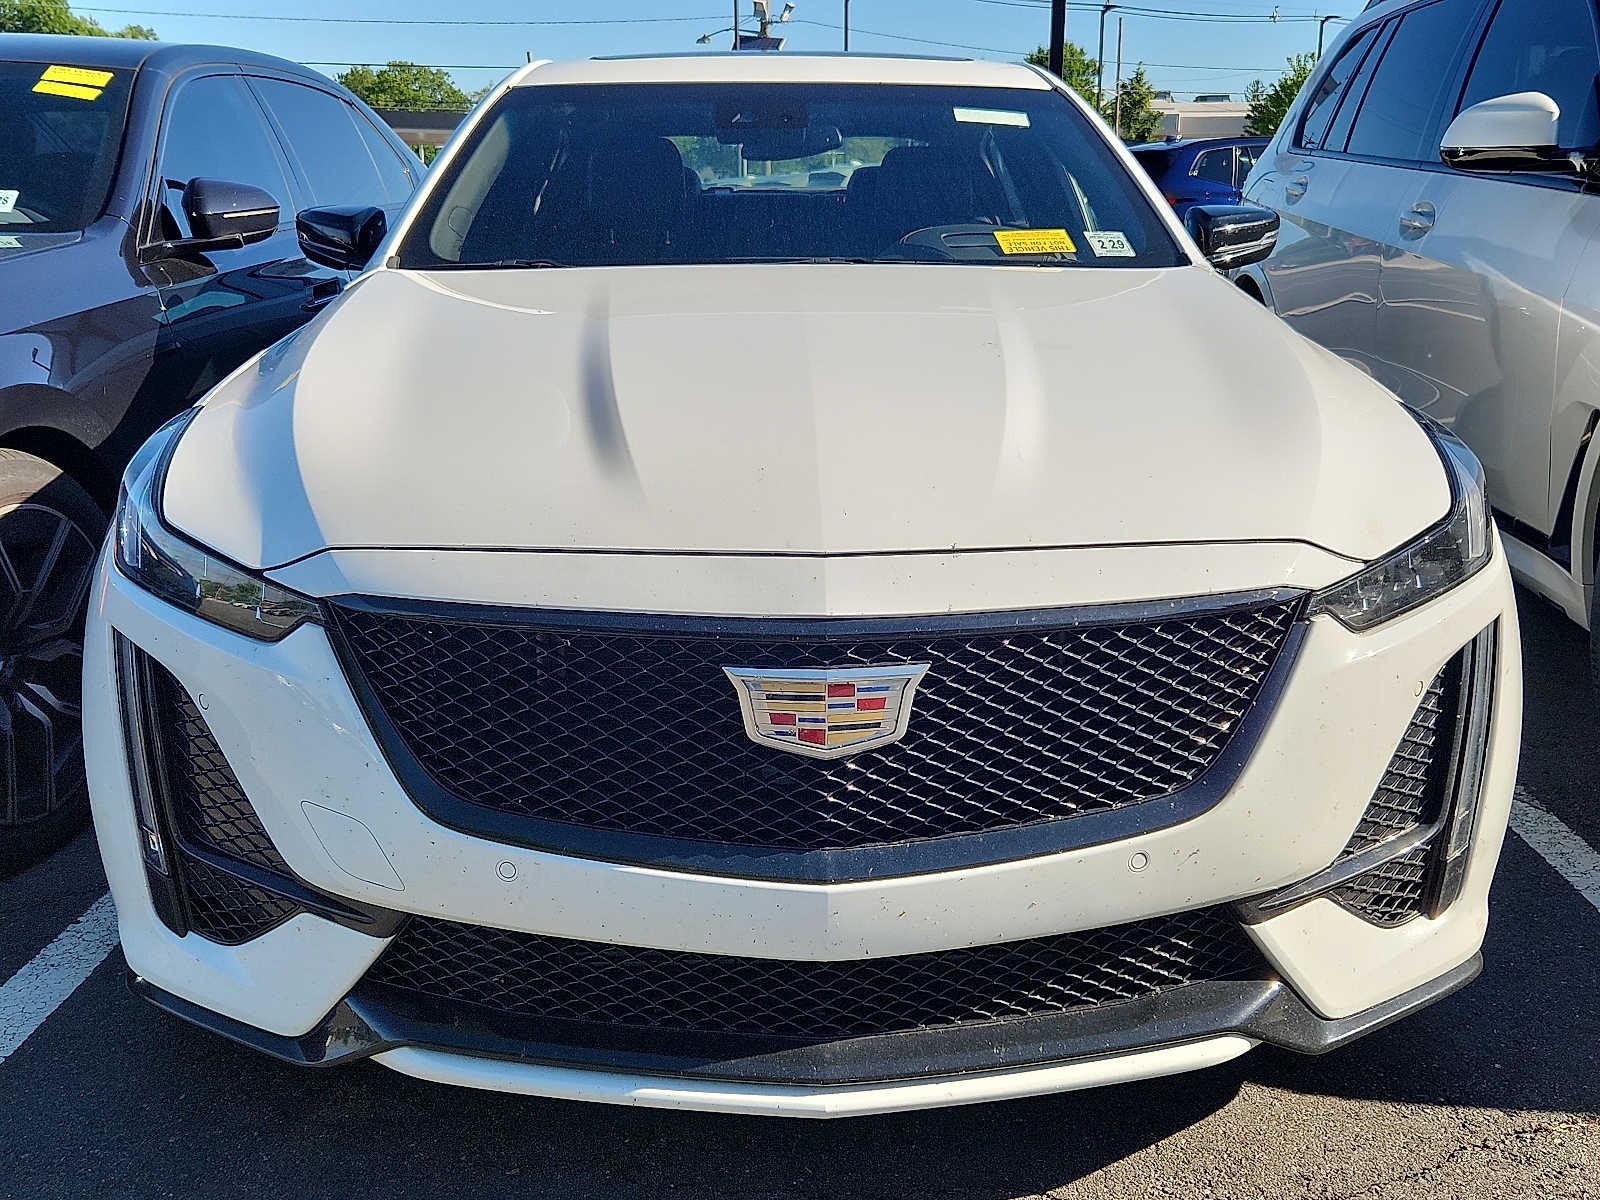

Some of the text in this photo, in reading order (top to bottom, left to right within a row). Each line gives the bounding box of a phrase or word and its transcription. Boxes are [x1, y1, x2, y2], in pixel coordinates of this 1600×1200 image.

[1006, 245, 1048, 253] VEHICLE
[1097, 239, 1125, 250] 2 29
